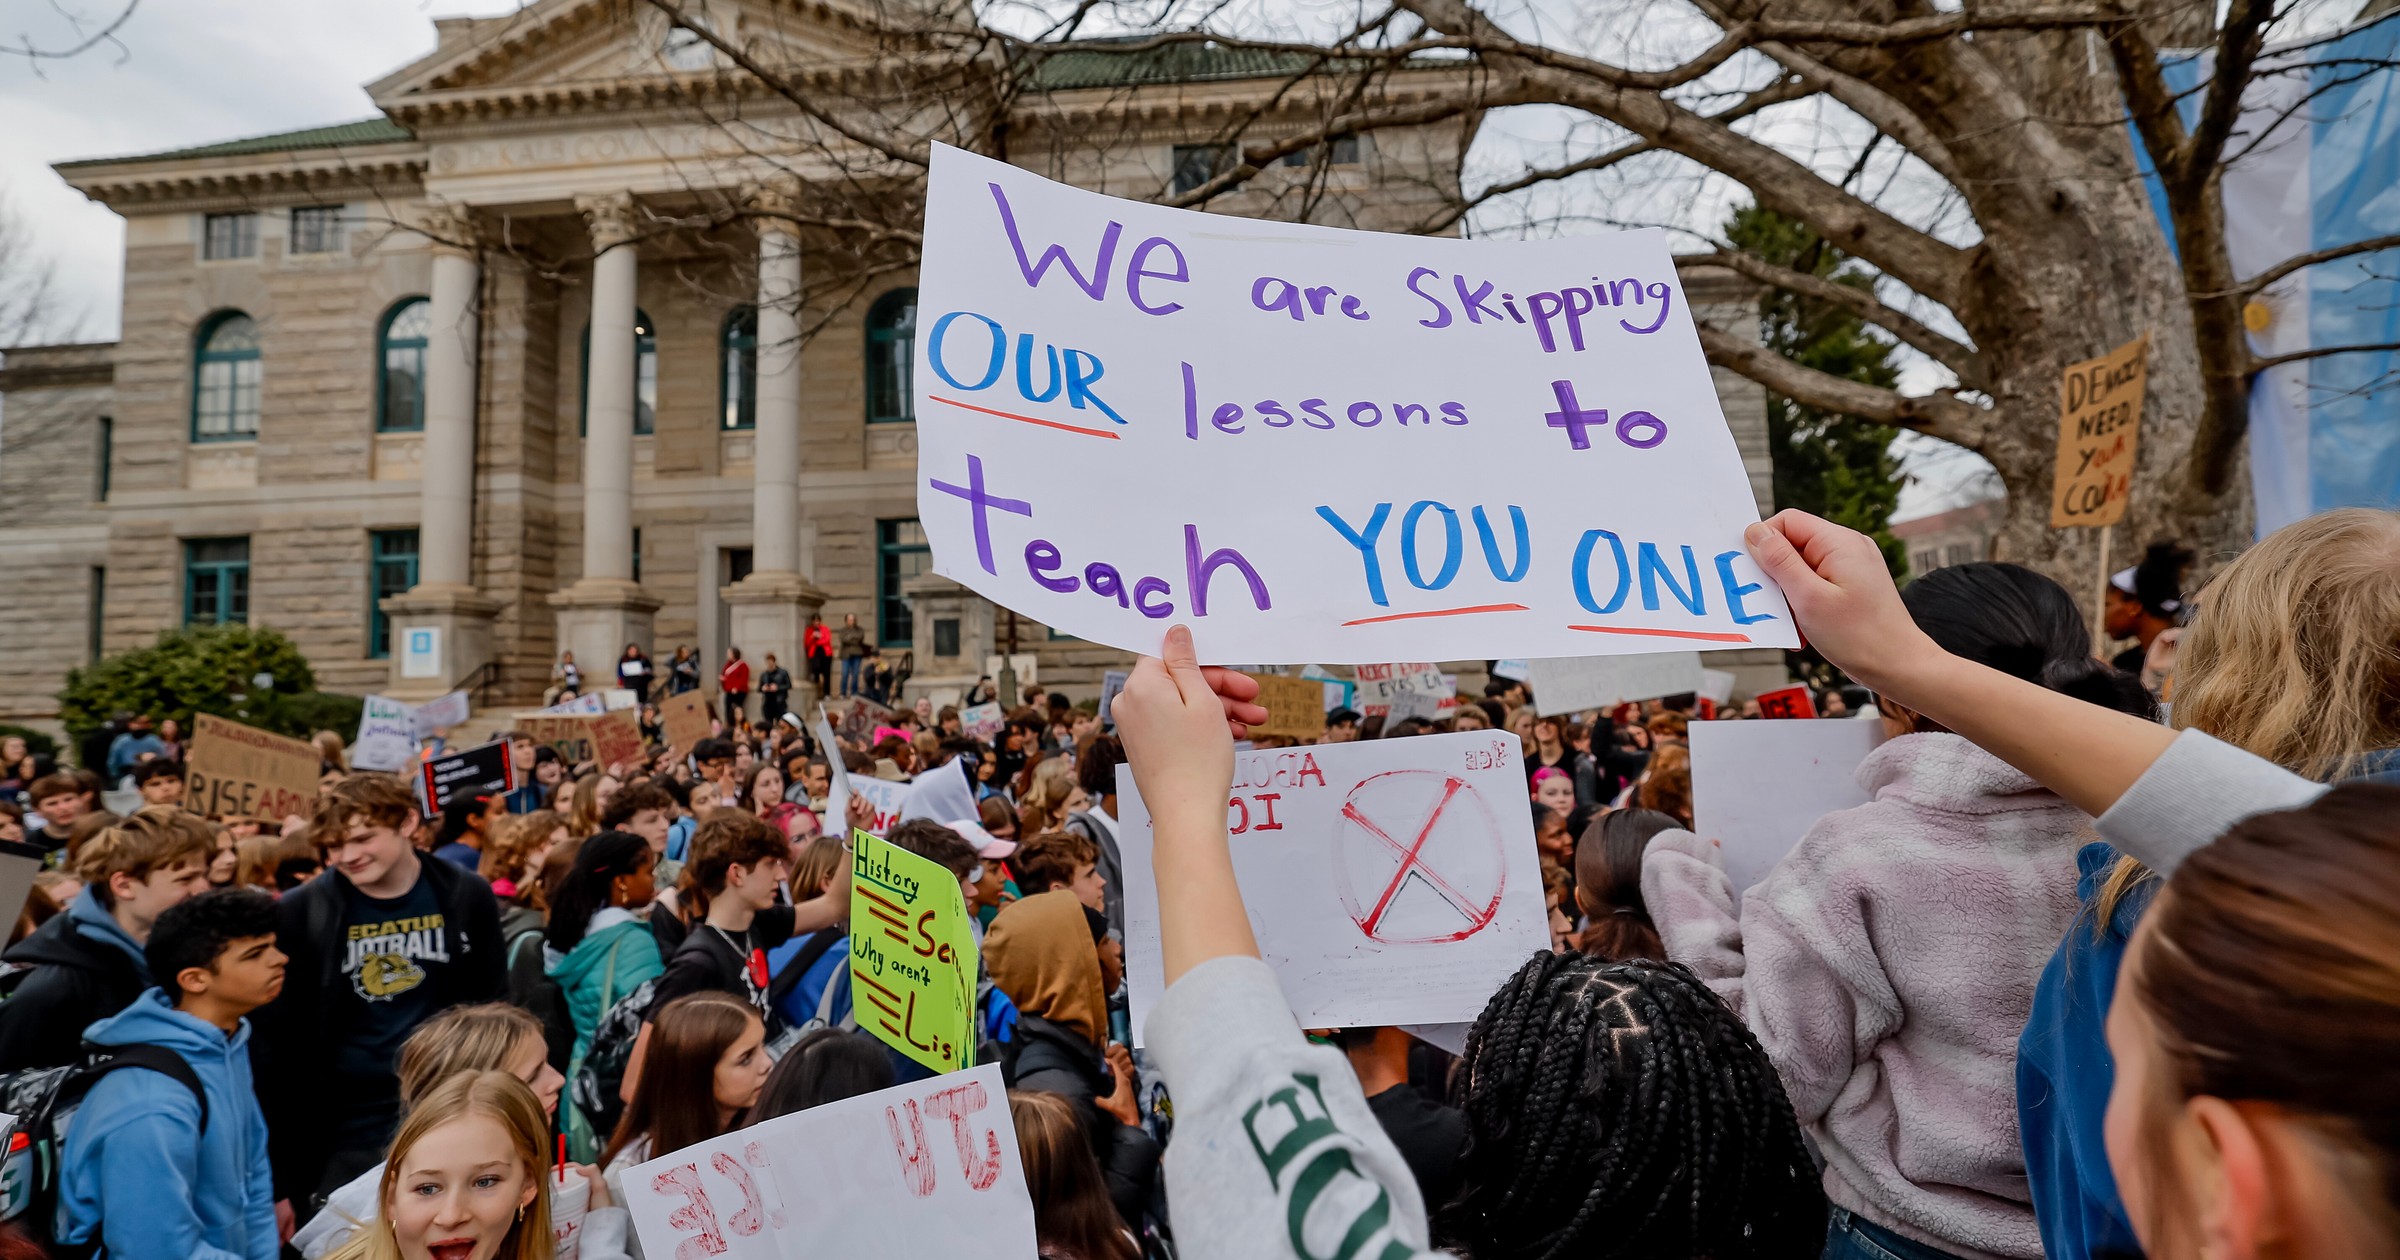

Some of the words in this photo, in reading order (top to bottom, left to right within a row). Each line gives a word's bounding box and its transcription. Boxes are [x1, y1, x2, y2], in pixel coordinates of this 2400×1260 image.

[989, 183, 1190, 316] We
[1251, 276, 1370, 321] are
[927, 311, 1128, 425] OUR
[1181, 361, 1469, 440] lessons
[1544, 380, 1668, 450] to
[929, 453, 1271, 619] teach
[1315, 500, 1531, 607] YOU
[1571, 529, 1778, 626] ONE
[186, 772, 257, 817] RISE
[855, 834, 919, 904] History
[347, 914, 445, 940] ECATUR
[853, 933, 884, 976] Why
